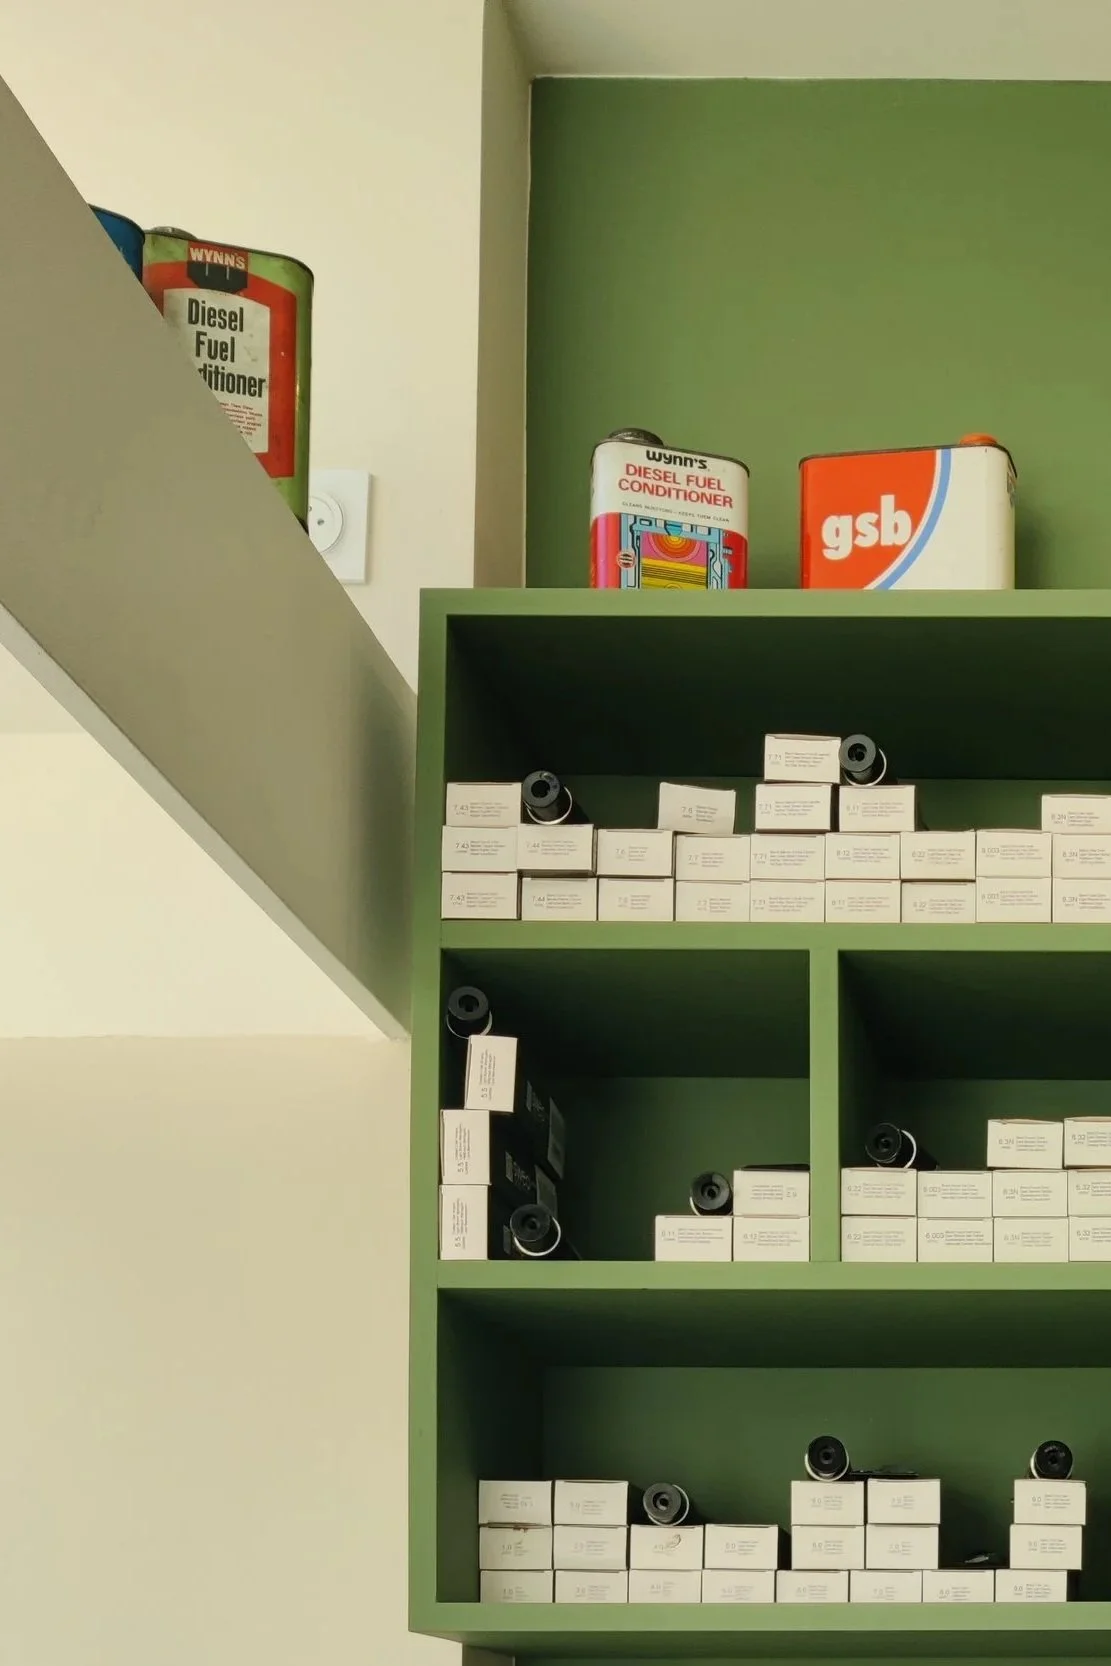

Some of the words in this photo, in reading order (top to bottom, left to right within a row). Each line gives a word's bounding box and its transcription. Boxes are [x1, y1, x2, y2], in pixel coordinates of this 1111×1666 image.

[189, 247, 246, 270] WYNN'S
[188, 297, 244, 332] Diesel
[195, 330, 236, 363] Fuel
[618, 478, 734, 509] CONDITIONER
[625, 463, 681, 485] DIESEL
[686, 474, 726, 492] FUEL
[822, 494, 912, 560] gsb
